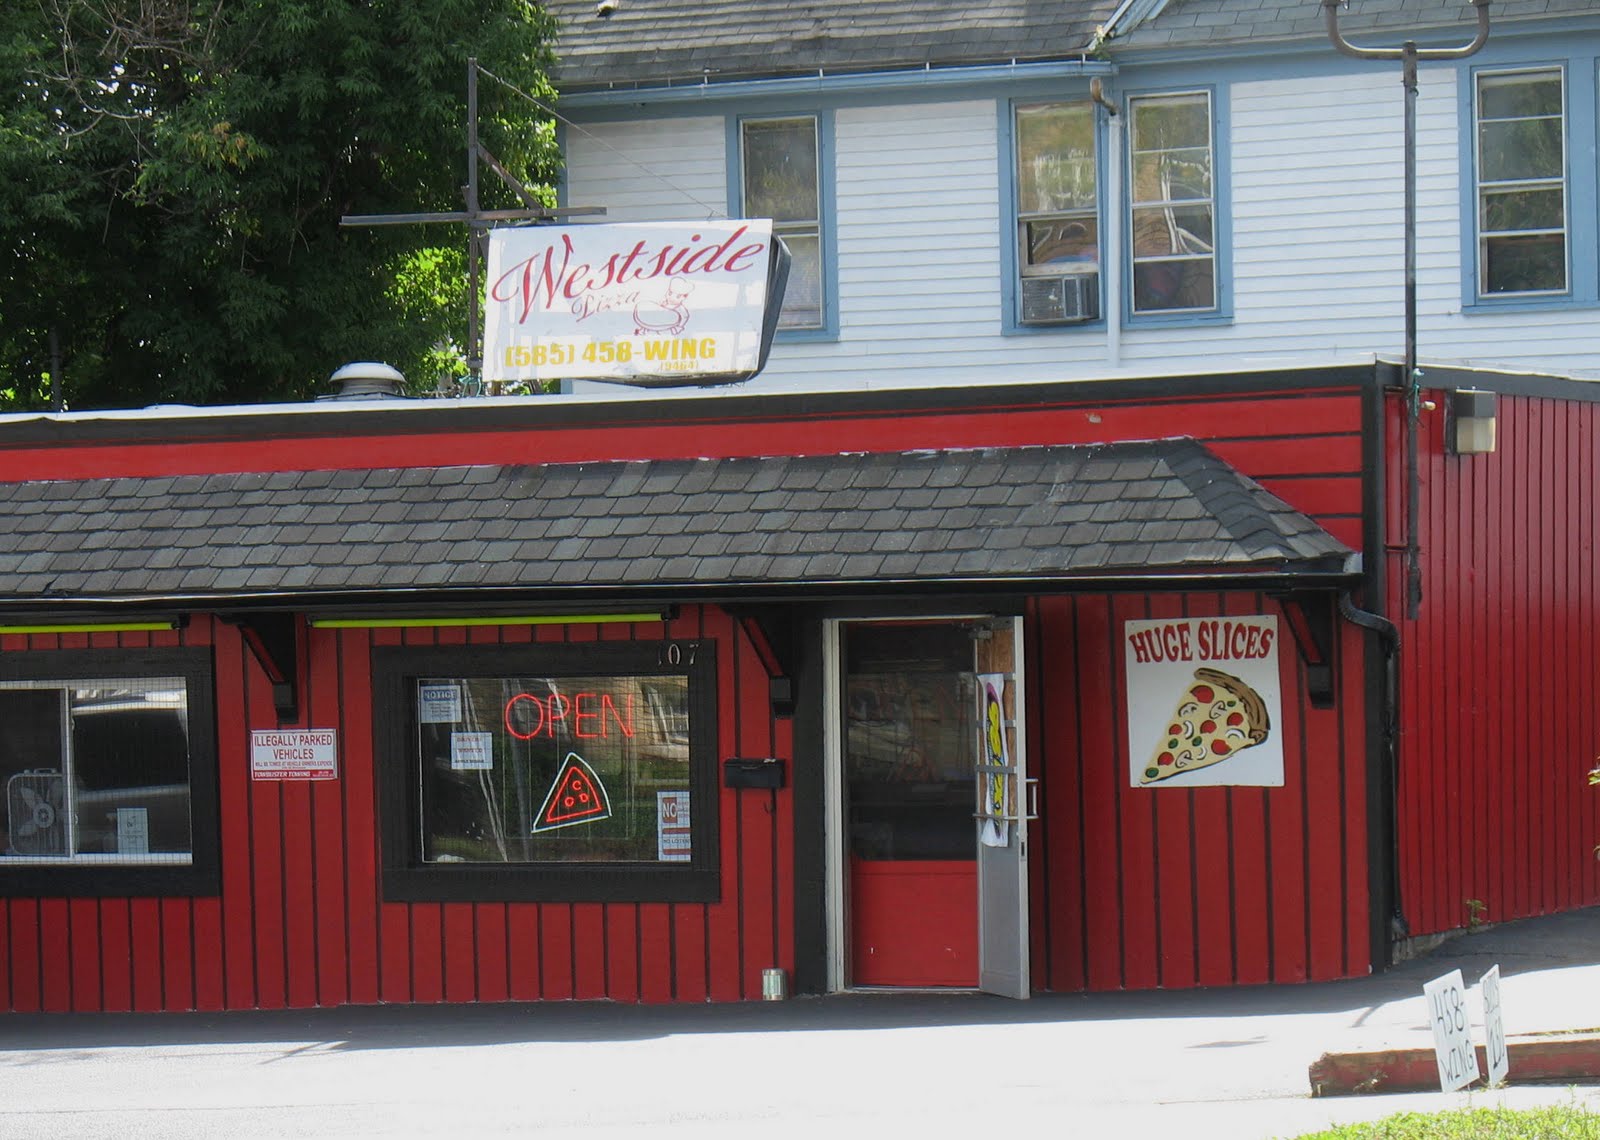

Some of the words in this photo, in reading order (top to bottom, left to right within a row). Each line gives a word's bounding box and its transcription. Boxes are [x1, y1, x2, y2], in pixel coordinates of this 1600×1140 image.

[491, 224, 765, 325] Westside
[504, 343, 575, 367] (585)
[582, 337, 716, 364] 458-WING
[1129, 623, 1193, 663] HUGE
[1198, 621, 1274, 660] SLICES
[424, 690, 457, 699] NOTICE
[505, 693, 634, 740] OPEN
[255, 735, 298, 747] ILLEGALLY
[300, 734, 333, 746] PARKED
[273, 748, 314, 760] VEHICLES
[663, 803, 677, 817] NO
[1440, 1039, 1475, 1083] WING
